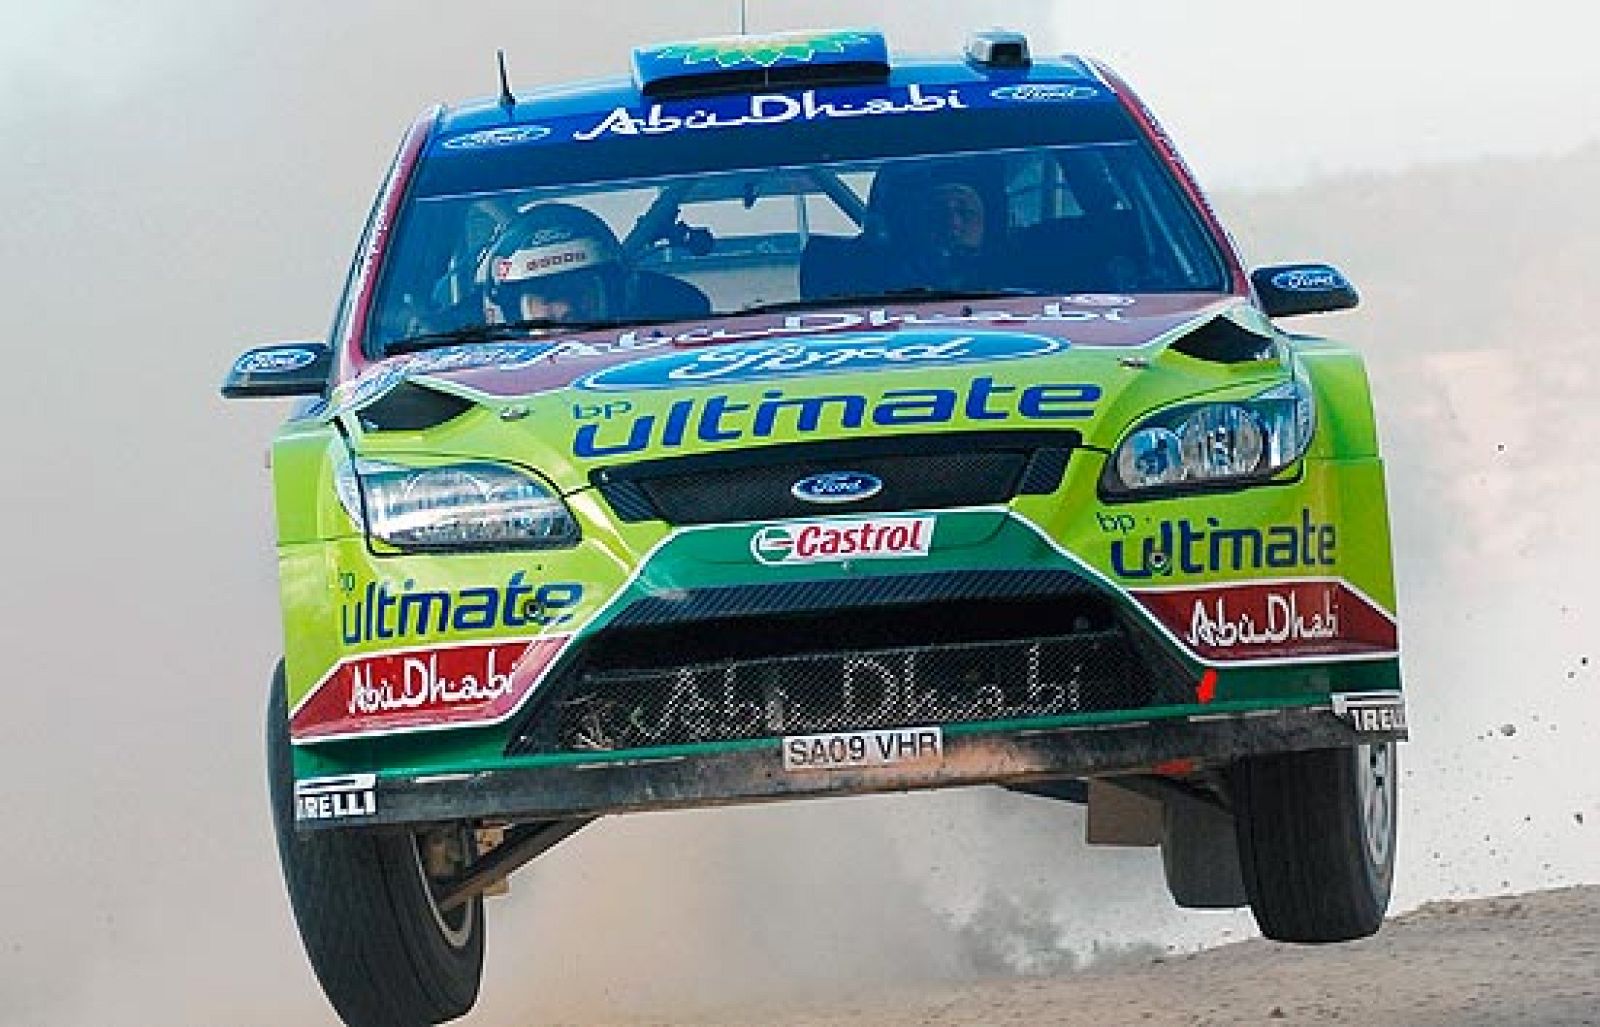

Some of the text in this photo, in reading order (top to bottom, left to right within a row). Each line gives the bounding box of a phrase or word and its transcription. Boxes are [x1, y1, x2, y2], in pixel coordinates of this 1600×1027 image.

[573, 83, 968, 141] Abu Dhabi
[667, 336, 978, 380] Ford
[573, 402, 632, 419] bp
[573, 376, 1102, 458] ultimate
[796, 520, 923, 557] Castrol
[1110, 506, 1336, 577] ultimate
[341, 569, 584, 644] ultimate
[1185, 598, 1263, 647] Abu
[348, 648, 515, 714] Abu Dhabi
[838, 641, 1083, 730] Dhabi
[788, 731, 940, 768] SA09 VHR
